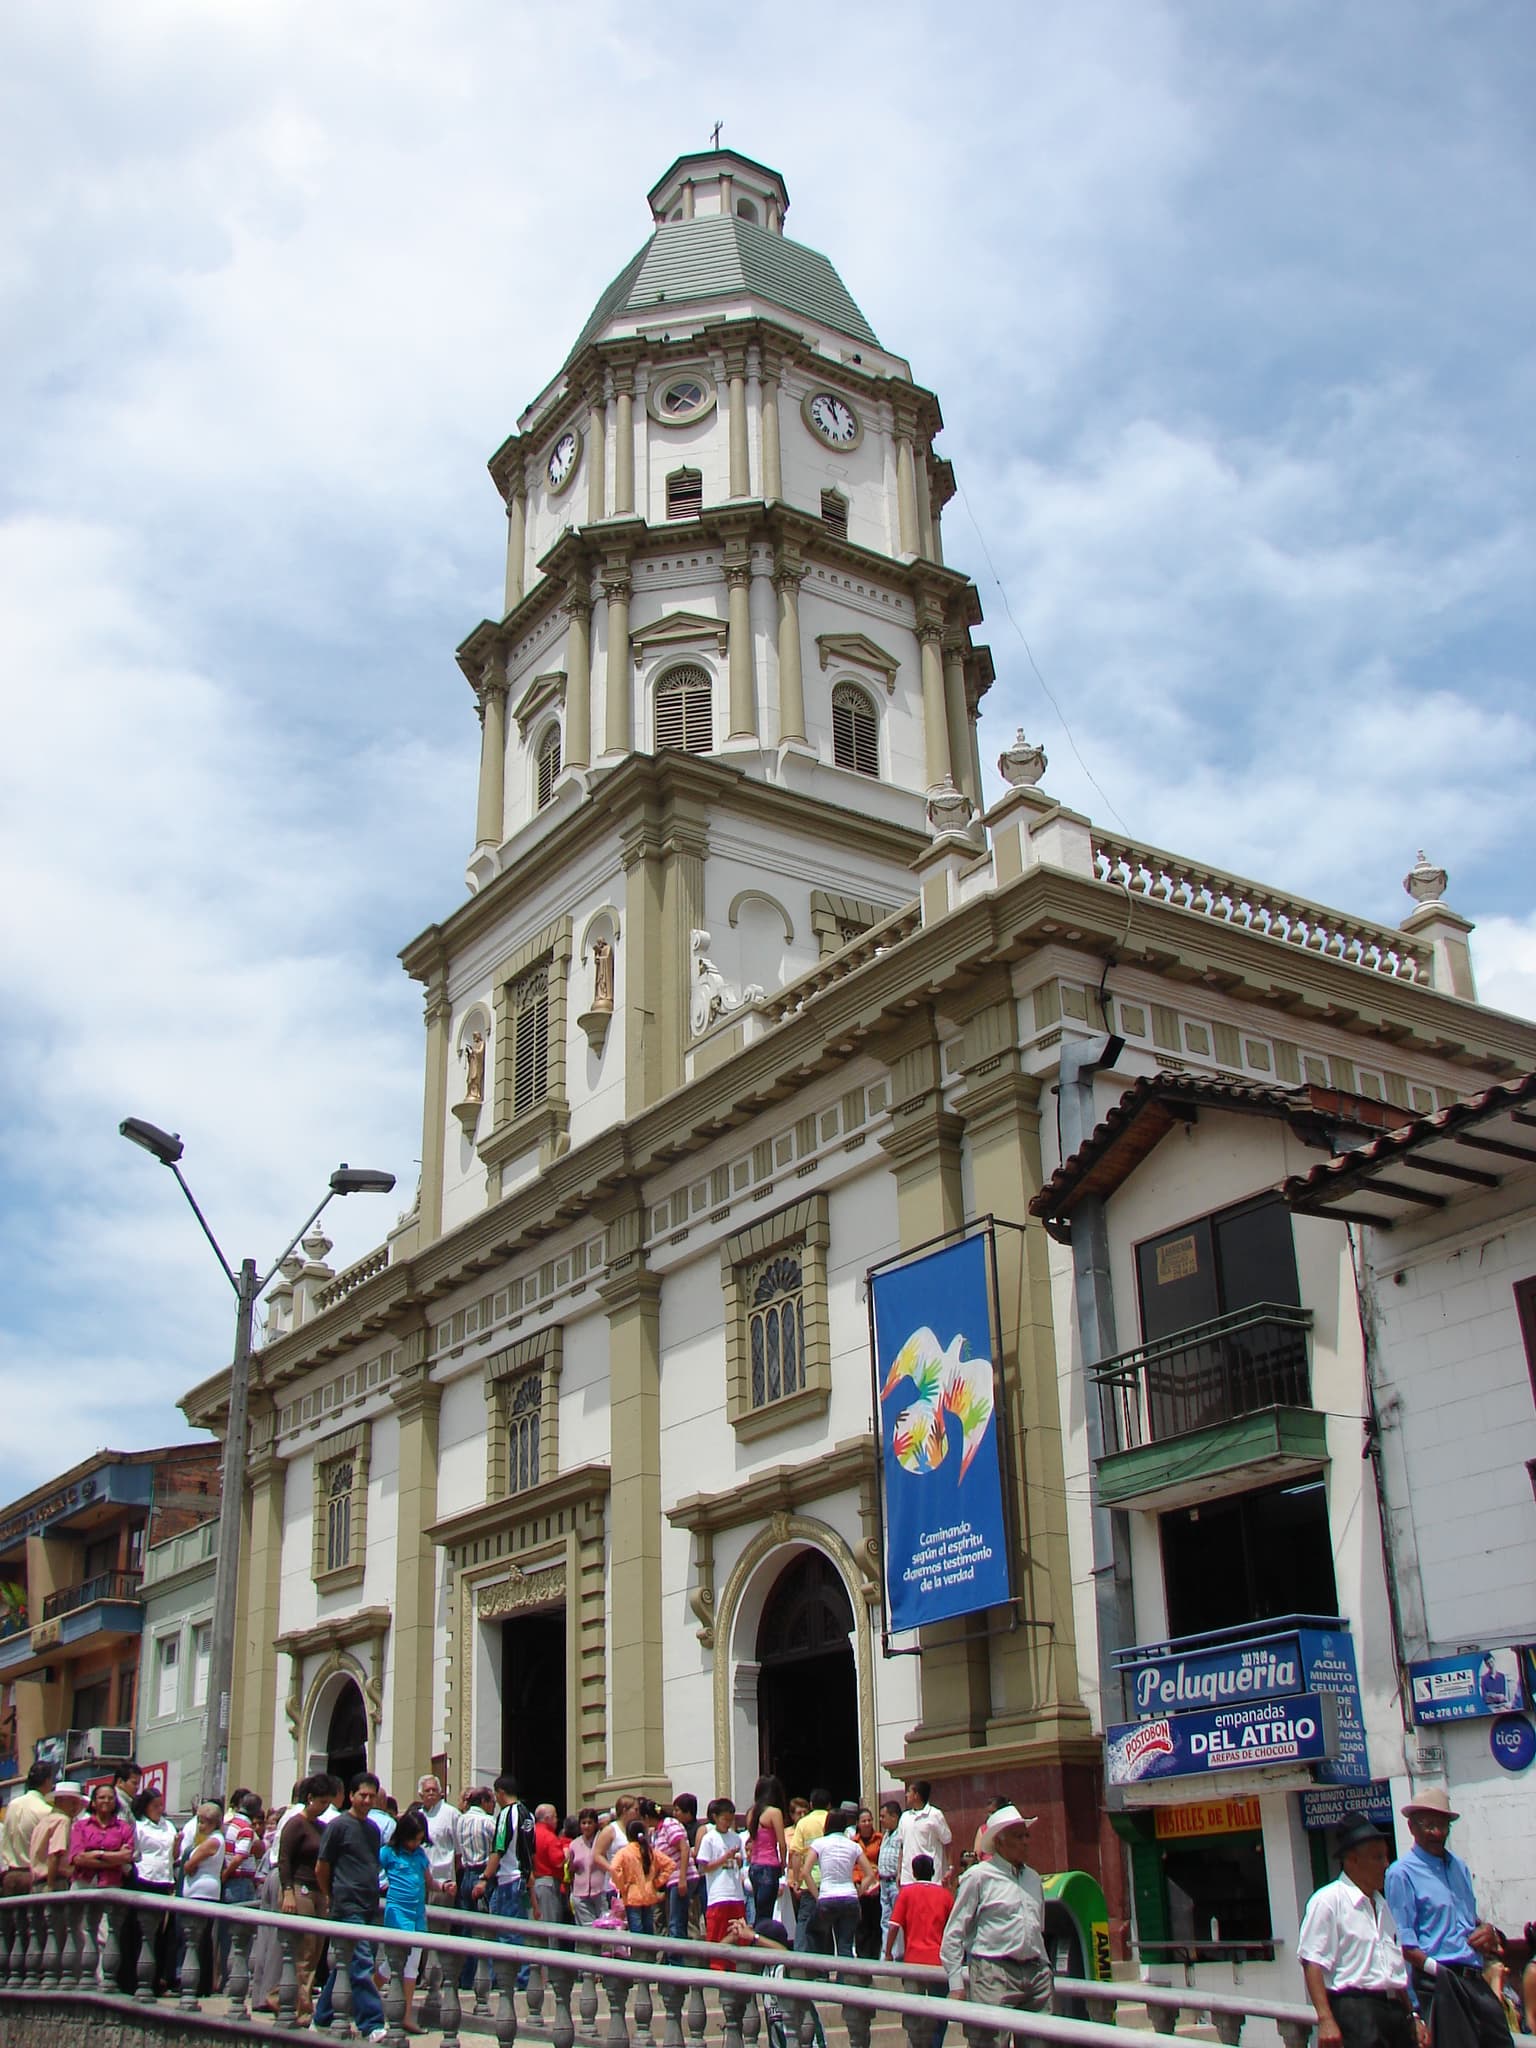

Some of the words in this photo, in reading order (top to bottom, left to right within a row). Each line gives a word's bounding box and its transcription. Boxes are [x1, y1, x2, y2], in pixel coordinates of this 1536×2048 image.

[919, 1520, 971, 1546] Caminando
[912, 1547, 938, 1565] según
[938, 1542, 946, 1556] el
[947, 1534, 983, 1554] espíritu
[903, 1562, 942, 1582] daremos
[943, 1546, 992, 1570] testimonio
[920, 1577, 933, 1593] de
[934, 1575, 942, 1588] la
[943, 1567, 975, 1584] verdad
[1313, 1660, 1346, 1670] AQUI
[1137, 1654, 1296, 1707] Peluqueria
[1310, 1671, 1353, 1682] MINUTO
[1434, 1672, 1471, 1684] S.I.N.
[1310, 1683, 1356, 1694] CELULAR
[1337, 1696, 1352, 1705] DE
[1215, 1703, 1285, 1728] empanadas
[1125, 1721, 1169, 1760] POSTOBON
[1190, 1730, 1236, 1755] DEL
[1241, 1718, 1316, 1747] ATRIO
[1496, 1731, 1521, 1745] tigo
[1211, 1752, 1241, 1764] AREPAS
[1242, 1749, 1253, 1760] DE
[1254, 1744, 1295, 1758] CHOCOLO
[1305, 1802, 1343, 1815] CABINAS
[1344, 1797, 1391, 1811] CERRADAS
[1207, 1808, 1223, 1825] DE
[1306, 1813, 1344, 1825] AUTORIZA
